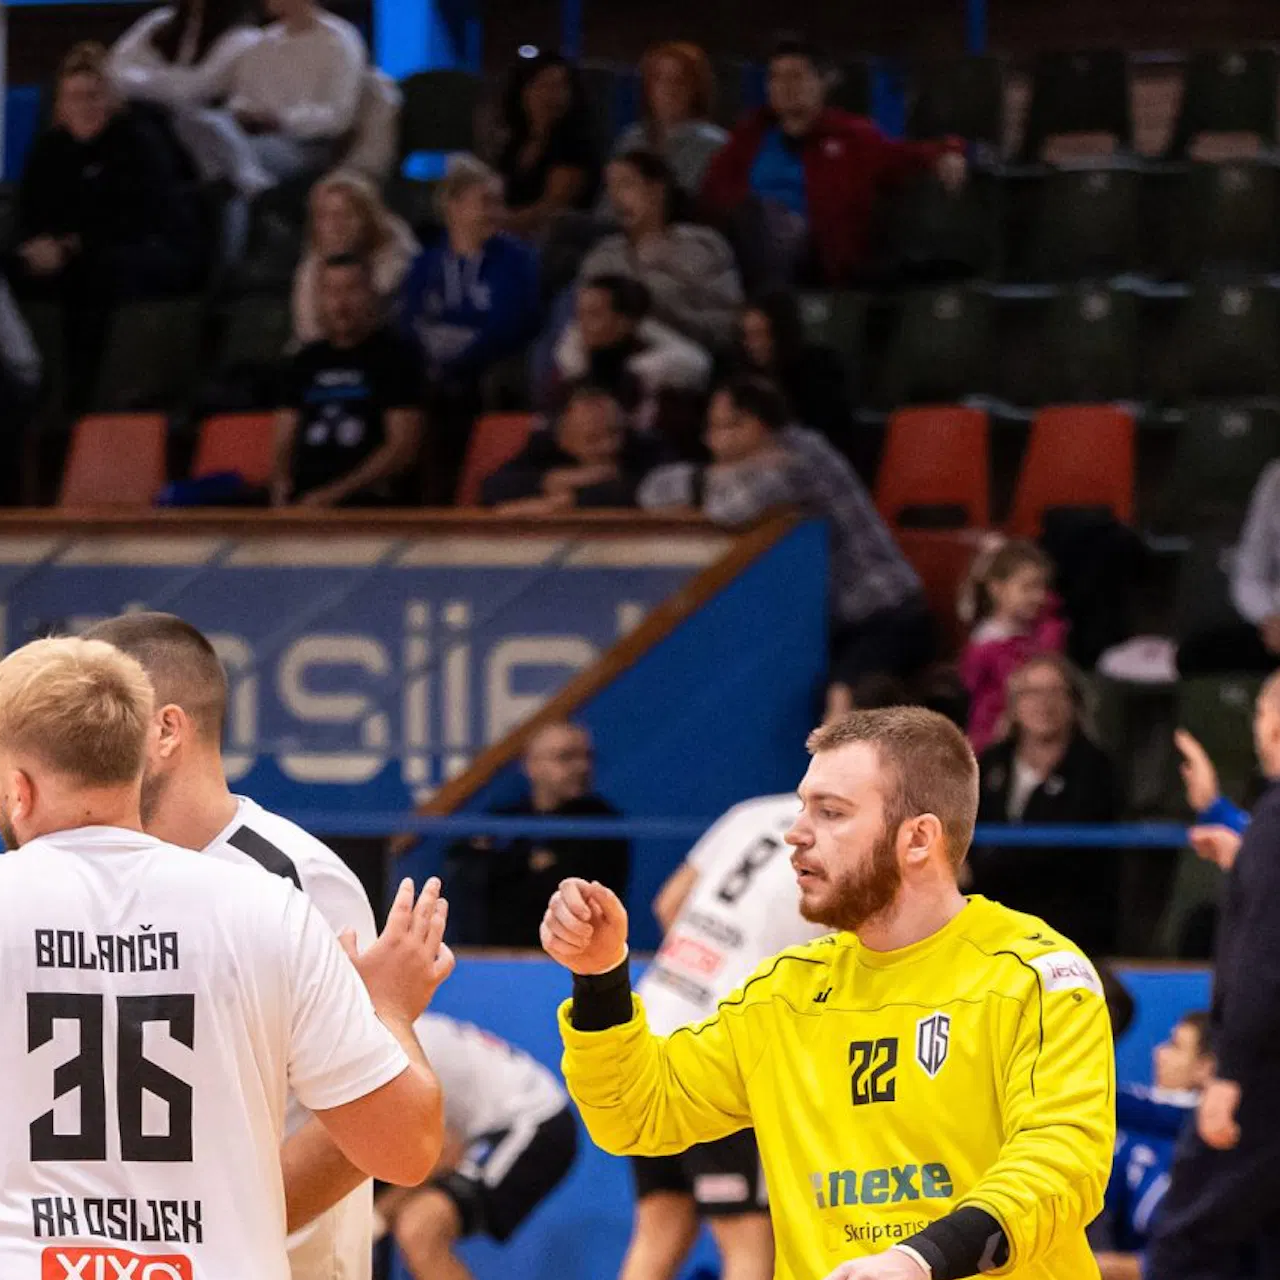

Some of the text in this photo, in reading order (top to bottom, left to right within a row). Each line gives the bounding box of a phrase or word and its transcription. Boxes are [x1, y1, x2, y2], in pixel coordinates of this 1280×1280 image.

[34, 923, 180, 973] BOLANČA
[26, 991, 195, 1162] 36
[848, 1037, 899, 1106] 22
[31, 1197, 204, 1244] RK OSIJEK
